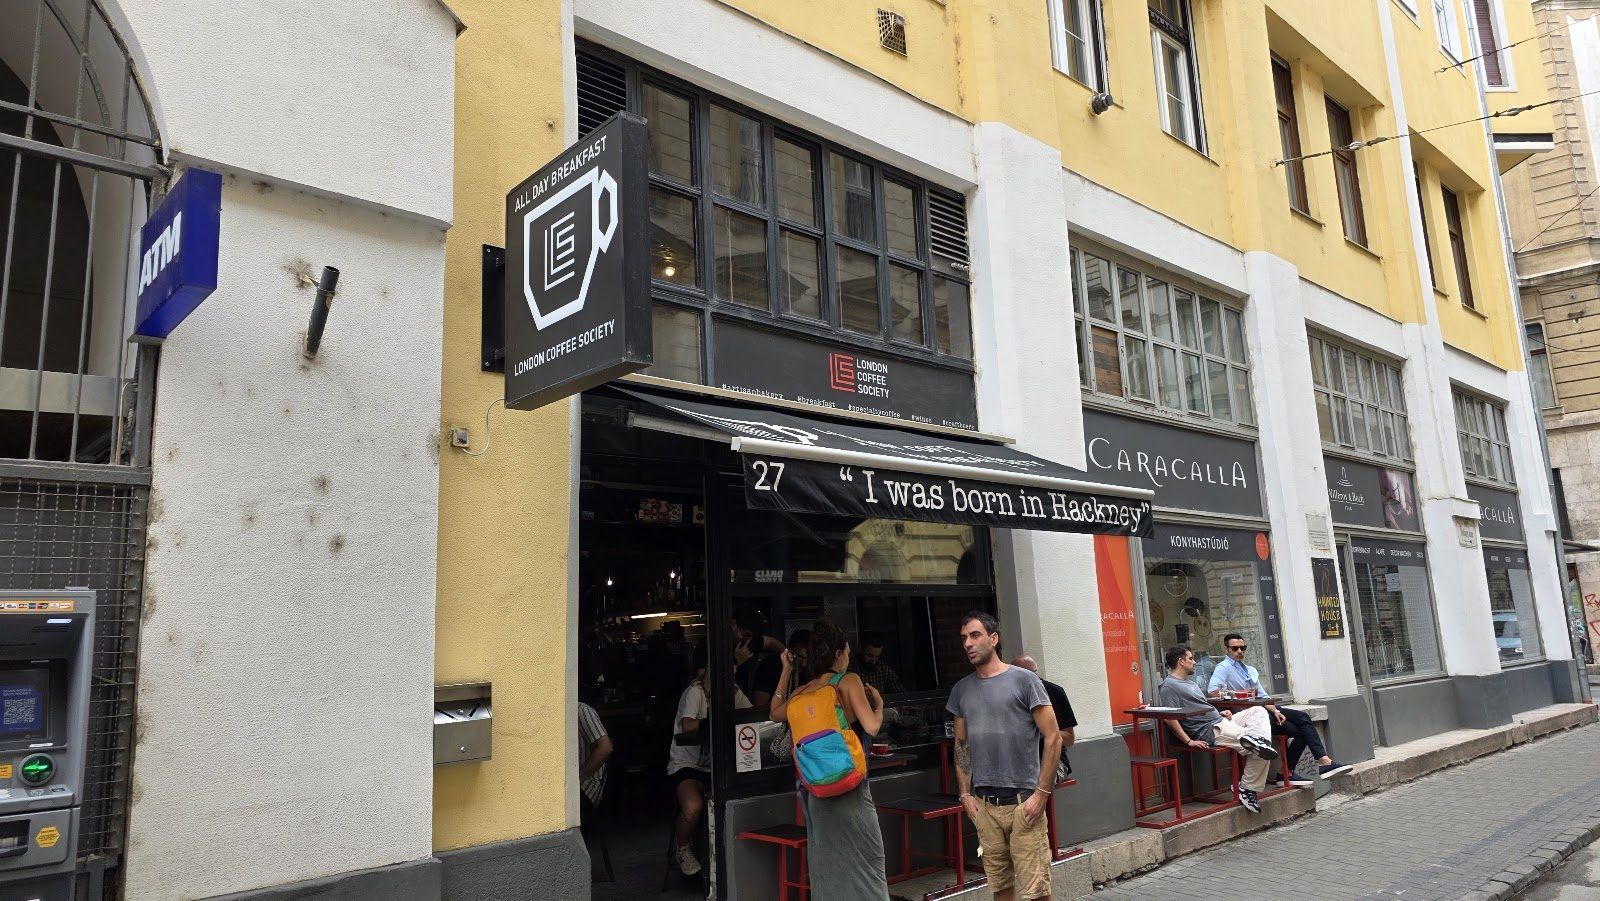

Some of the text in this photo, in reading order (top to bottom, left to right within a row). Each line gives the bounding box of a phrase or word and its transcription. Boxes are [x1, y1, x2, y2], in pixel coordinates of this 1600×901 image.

[514, 135, 607, 213] ALL DAY BREAKFAST
[138, 211, 182, 297] ATM
[514, 318, 615, 377] LONDON COFFEE SOCIETY
[856, 358, 888, 374] LONDON
[857, 371, 886, 386] COFFEE
[797, 395, 836, 408] #breakfast
[858, 384, 889, 399] SOCIETY
[753, 460, 785, 492] 27
[884, 479, 944, 510] was
[949, 480, 1016, 516] born
[1021, 489, 1046, 518] in
[1047, 492, 1150, 532] Hackney”
[1170, 535, 1229, 550] KONYHASTÚDIÓ
